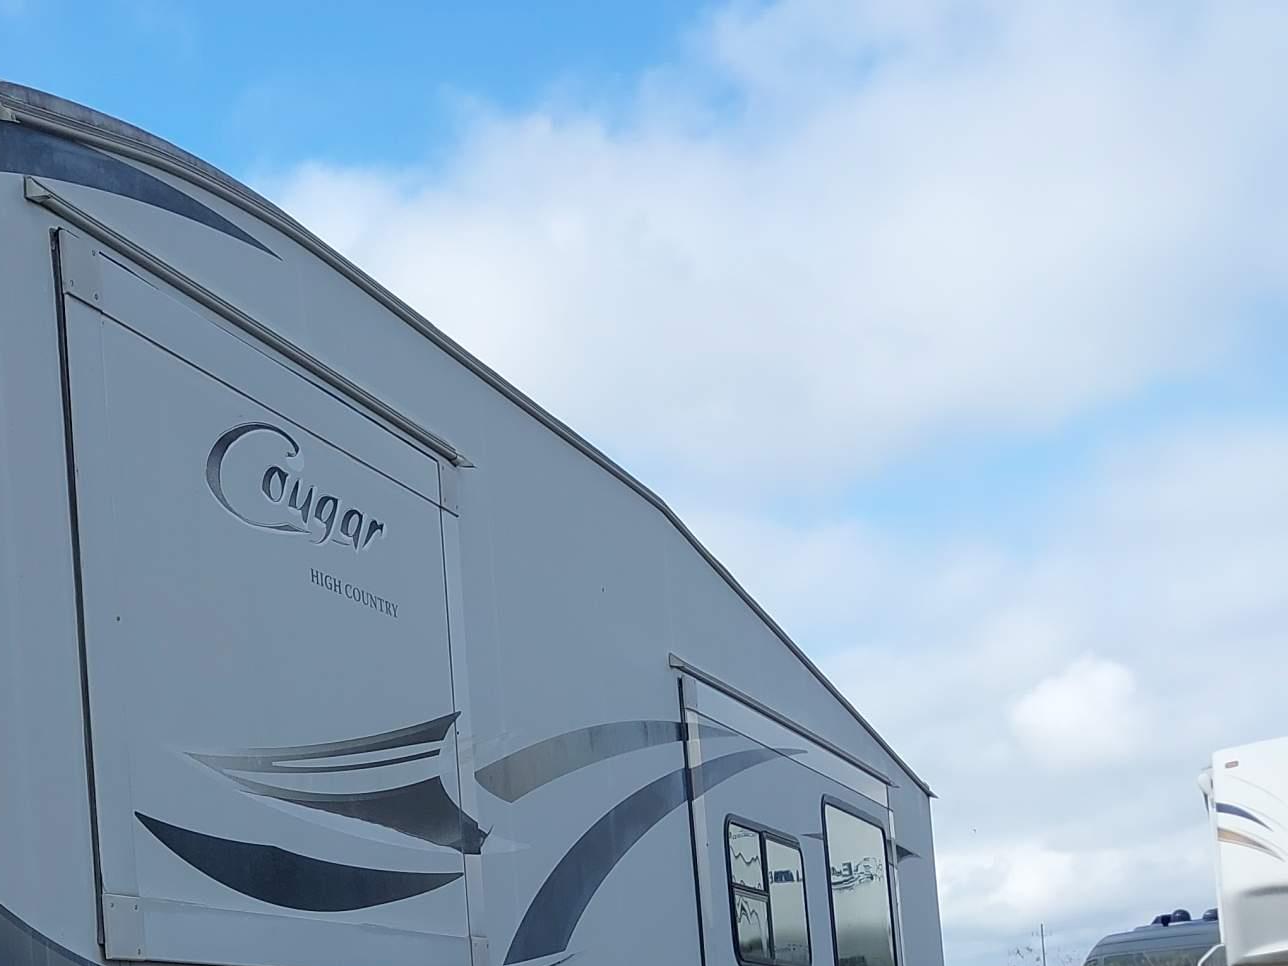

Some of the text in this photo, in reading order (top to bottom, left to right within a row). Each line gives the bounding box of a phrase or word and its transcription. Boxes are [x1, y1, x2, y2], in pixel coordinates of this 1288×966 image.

[205, 421, 384, 550] Cougar
[310, 567, 399, 618] HIGH COUNTRY
